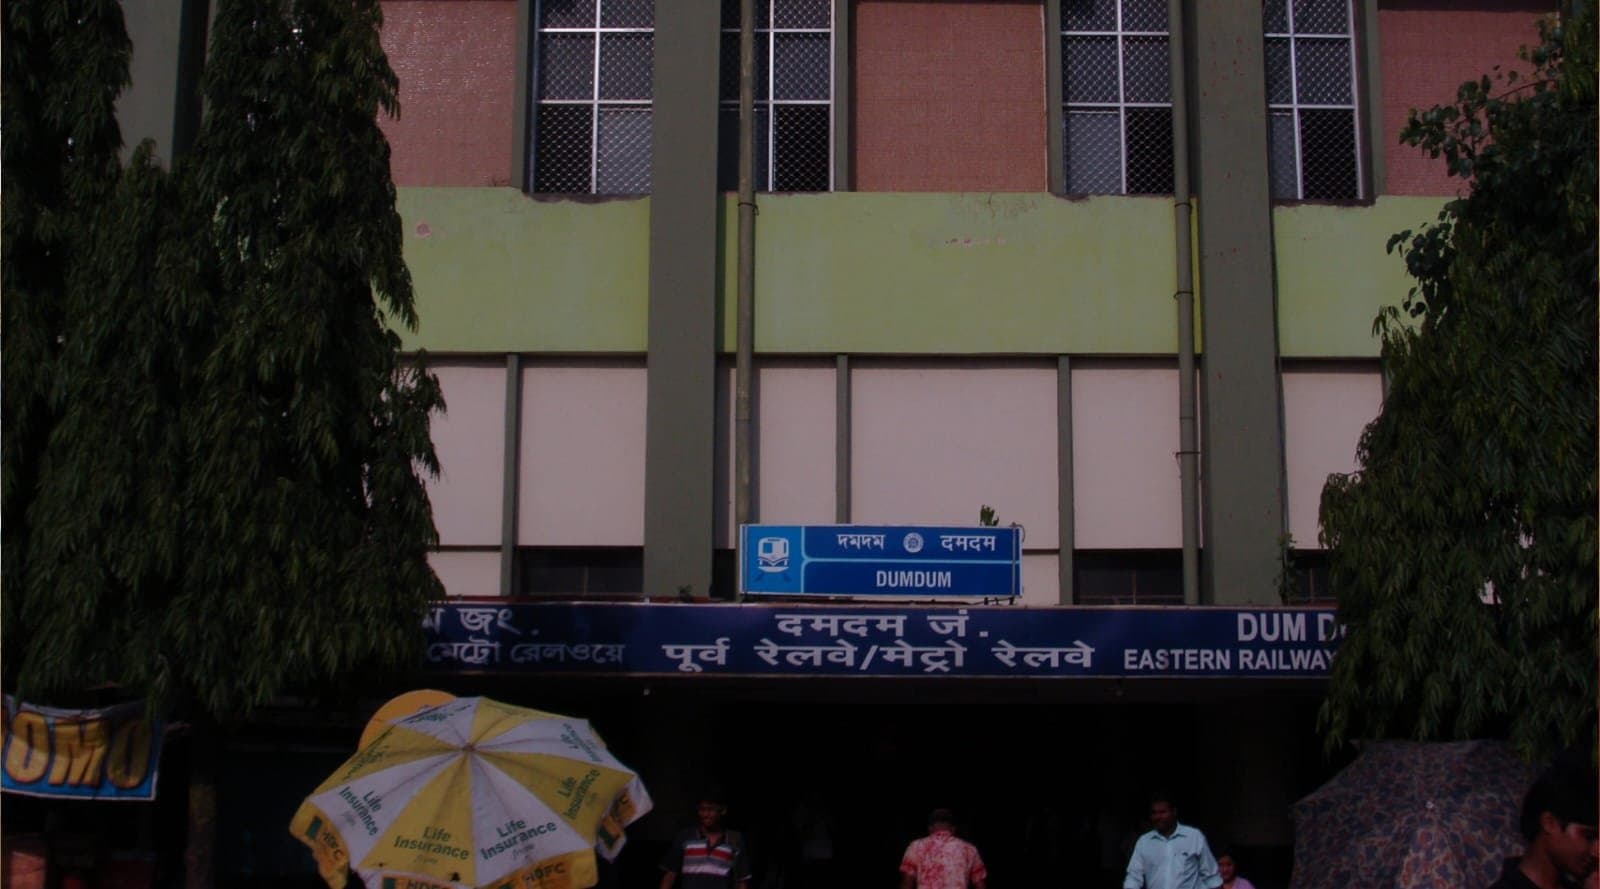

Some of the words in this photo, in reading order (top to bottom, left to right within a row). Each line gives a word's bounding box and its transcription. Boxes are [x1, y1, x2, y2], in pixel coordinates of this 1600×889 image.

[837, 533, 886, 551] দমদম
[940, 534, 997, 552] दमदम
[876, 570, 952, 588] DUMDUM
[775, 613, 907, 638] दमदम
[1237, 612, 1307, 642] DUM
[661, 638, 731, 672] पूर्व
[990, 639, 1096, 669] रेलवे
[1123, 648, 1231, 671] EASTERN
[339, 786, 379, 836] Insurance
[363, 790, 382, 812] Life
[423, 825, 452, 842] Life
[496, 818, 526, 838] Life
[394, 835, 470, 861] Insurance
[480, 821, 557, 861] Insurance
